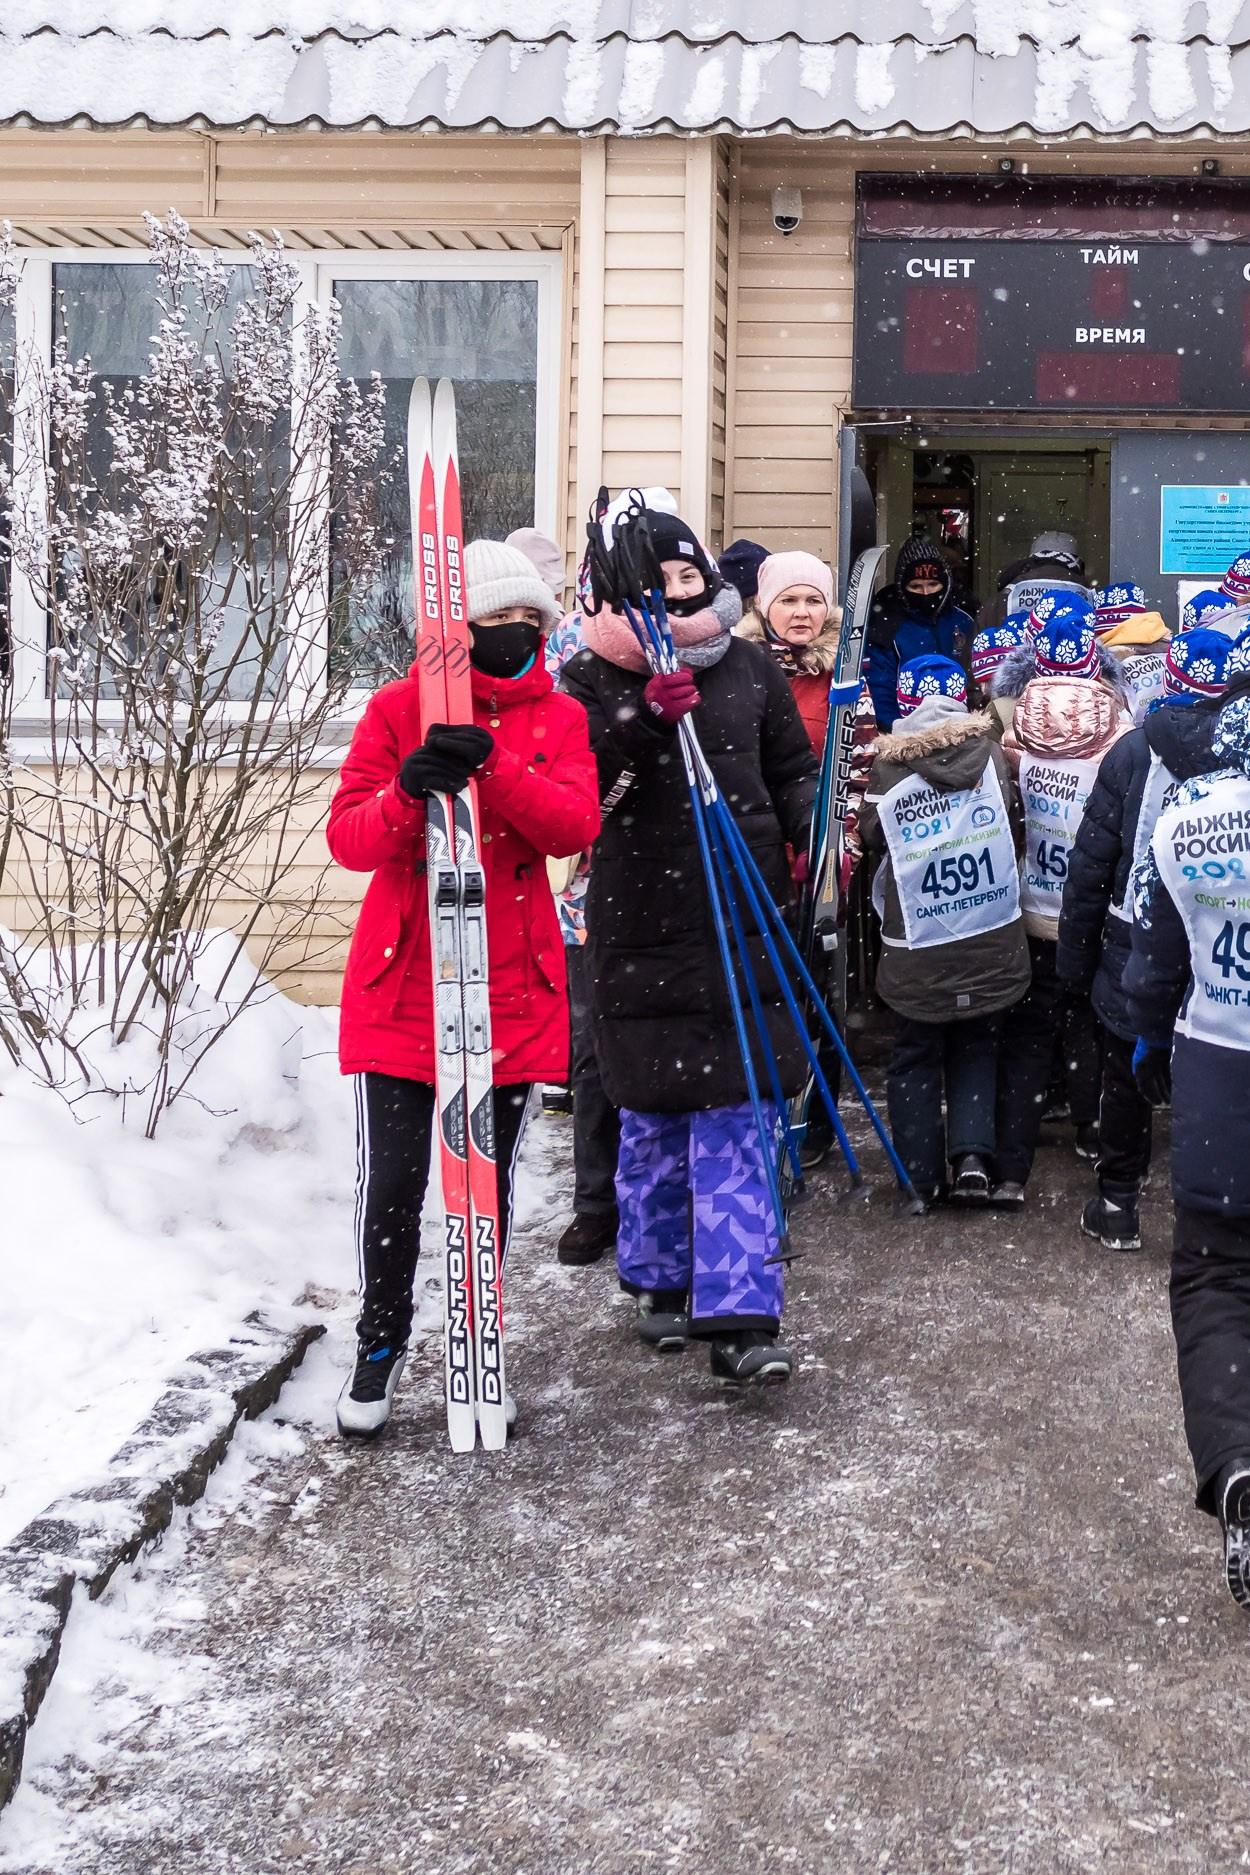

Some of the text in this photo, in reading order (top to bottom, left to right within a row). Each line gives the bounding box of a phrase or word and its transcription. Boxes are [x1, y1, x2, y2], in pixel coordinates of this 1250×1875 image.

[906, 258, 976, 279] СЧЕТ
[1080, 245, 1140, 265] ТАЙМ
[1075, 327, 1146, 344] ВРЕМЯ
[421, 532, 439, 620] CROSS
[446, 534, 464, 622] CROSS
[915, 564, 939, 579] NYC
[1132, 672, 1162, 694] 202
[832, 709, 858, 824] FISCHER
[1026, 765, 1080, 789] ЛЫЖНЯ
[1026, 779, 1076, 803] РОССИИ
[895, 797, 951, 825] РОССИИ
[1028, 794, 1070, 821] 2021
[901, 815, 952, 844] 2021
[1036, 839, 1068, 878] 45
[921, 847, 995, 899] 4591
[916, 885, 1010, 919] САНКТ-ПЕТЕРБУРГ
[446, 1214, 470, 1405] DENTON
[476, 1216, 502, 1406] DENTON
